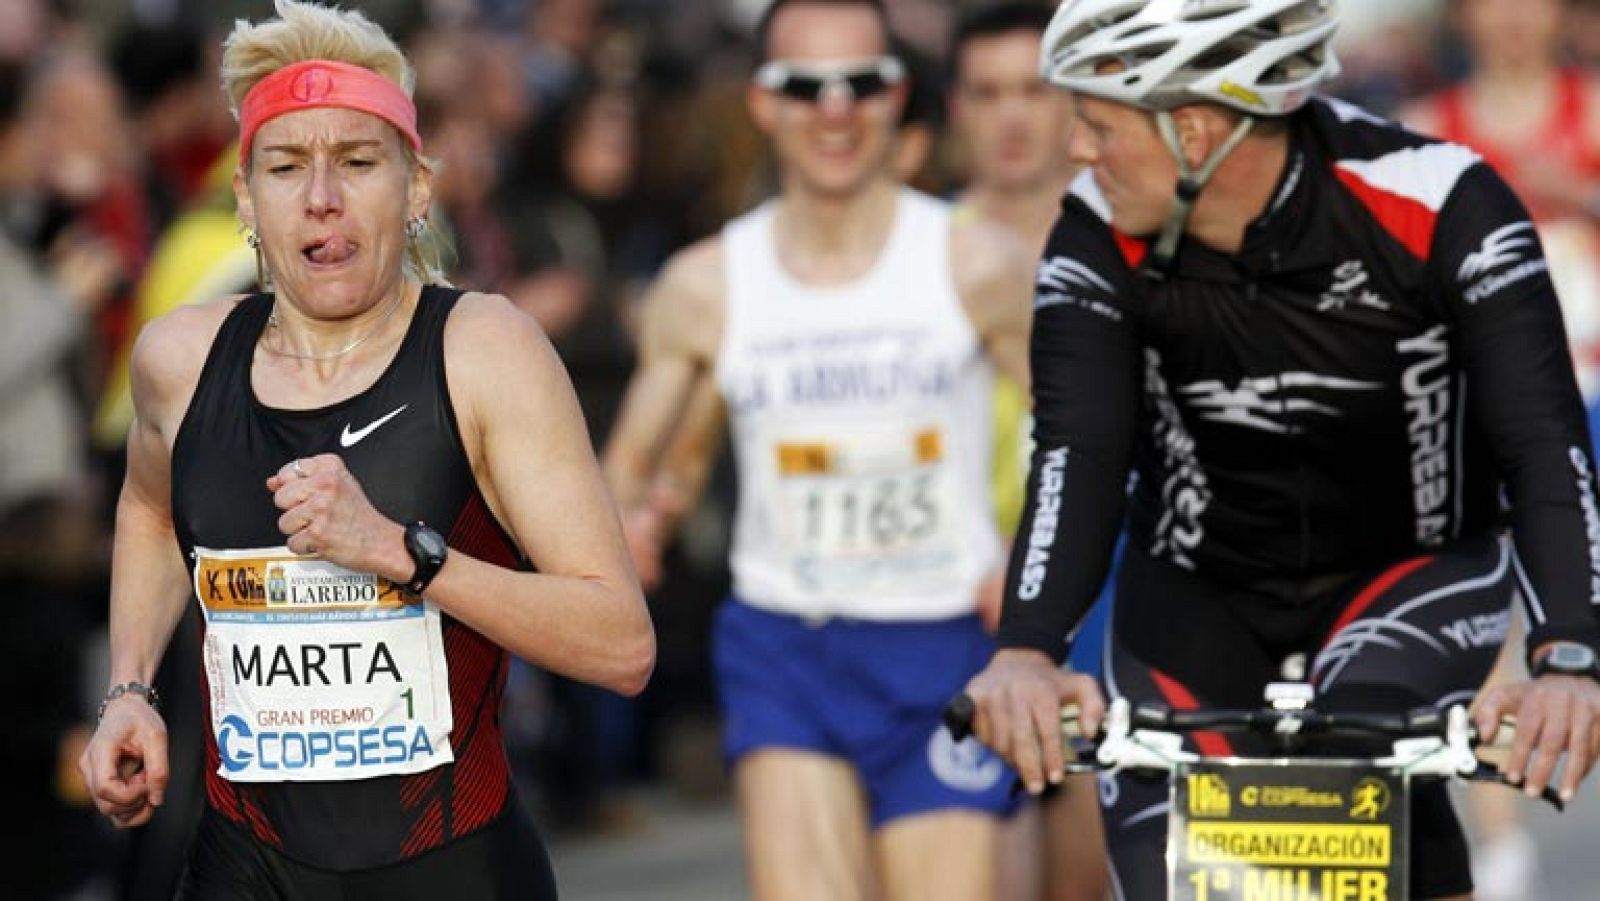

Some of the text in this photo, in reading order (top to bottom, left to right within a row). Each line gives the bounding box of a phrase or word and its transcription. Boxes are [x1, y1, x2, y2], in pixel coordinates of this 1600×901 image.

[291, 583, 376, 604] LAREDO
[232, 641, 403, 687] MARTA
[257, 707, 374, 727] GRAN PREMIO
[400, 687, 414, 720] 1
[256, 724, 434, 770] COPSESA
[1194, 829, 1384, 860] ORGANIZACIÓN
[1243, 869, 1389, 901] MUJER
